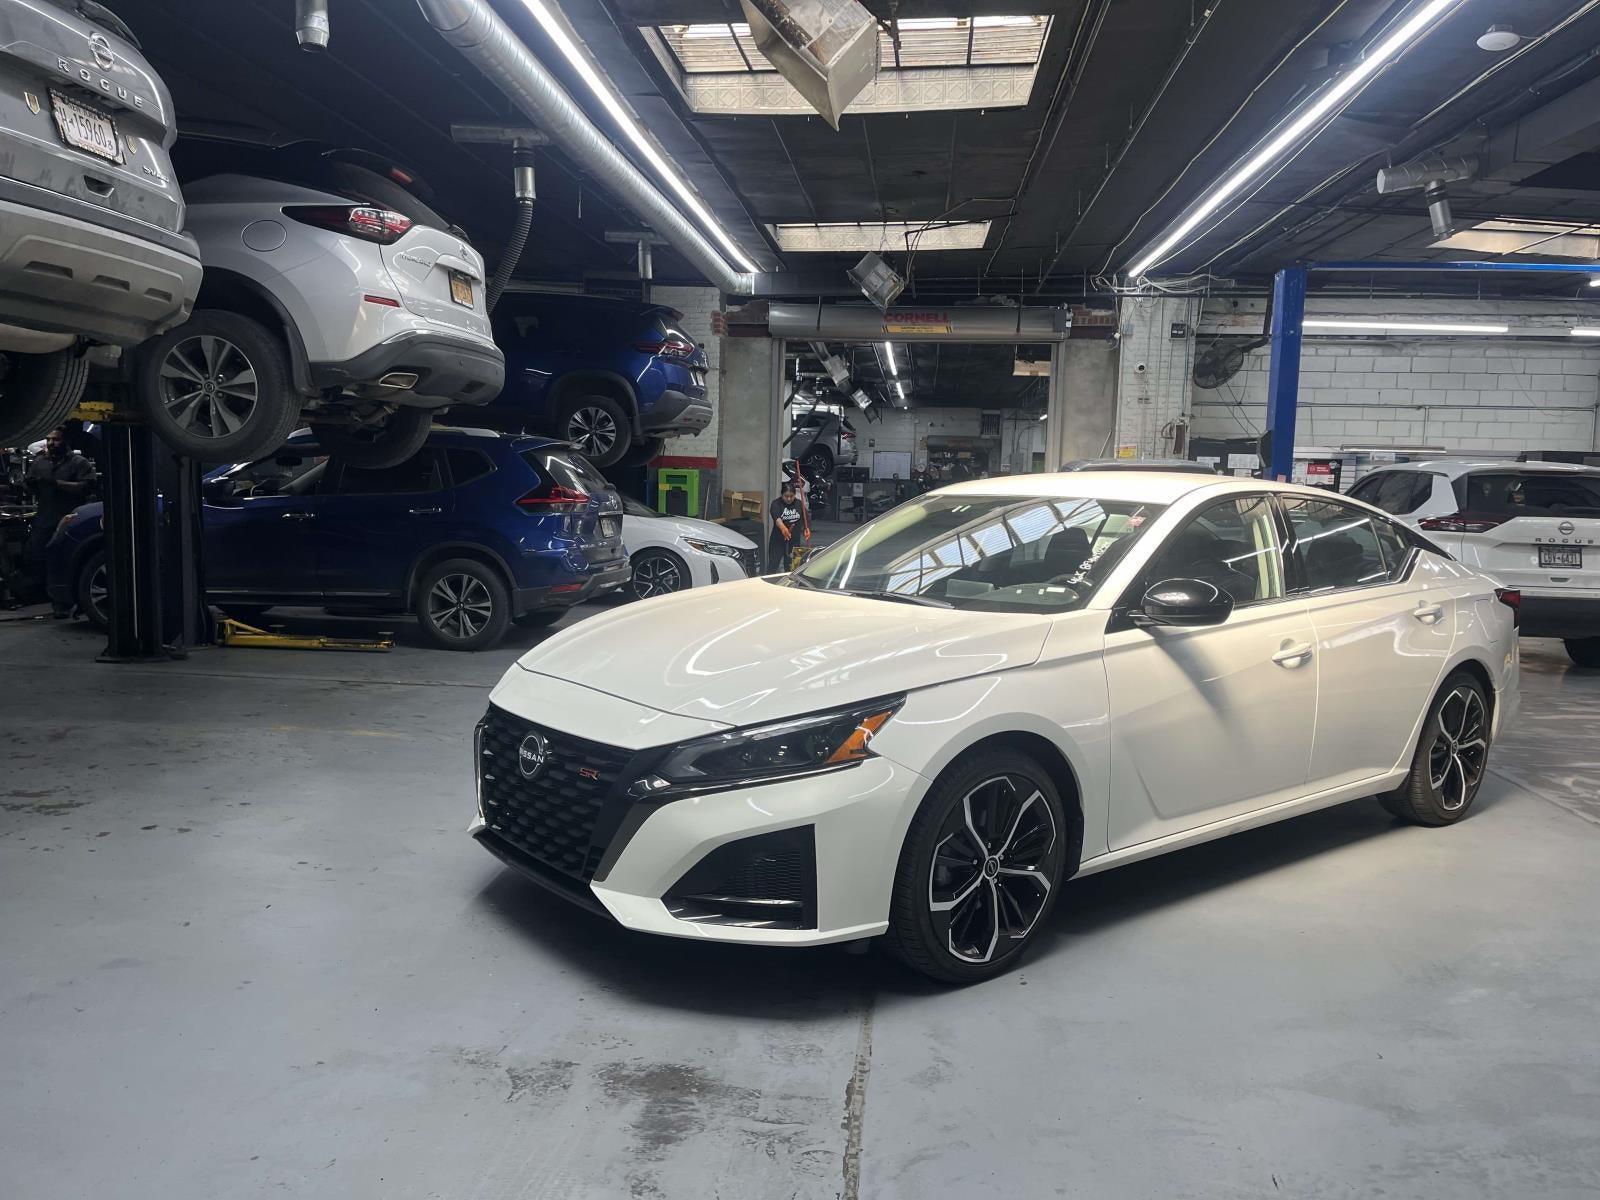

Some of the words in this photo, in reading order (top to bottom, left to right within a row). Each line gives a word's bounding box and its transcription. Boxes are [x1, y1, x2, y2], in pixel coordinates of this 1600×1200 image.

[58, 57, 143, 109] ROGUE
[884, 312, 951, 323] CORNELL
[1535, 537, 1594, 545] ROGUE
[519, 746, 544, 763] NISSAN
[579, 767, 600, 781] SR
